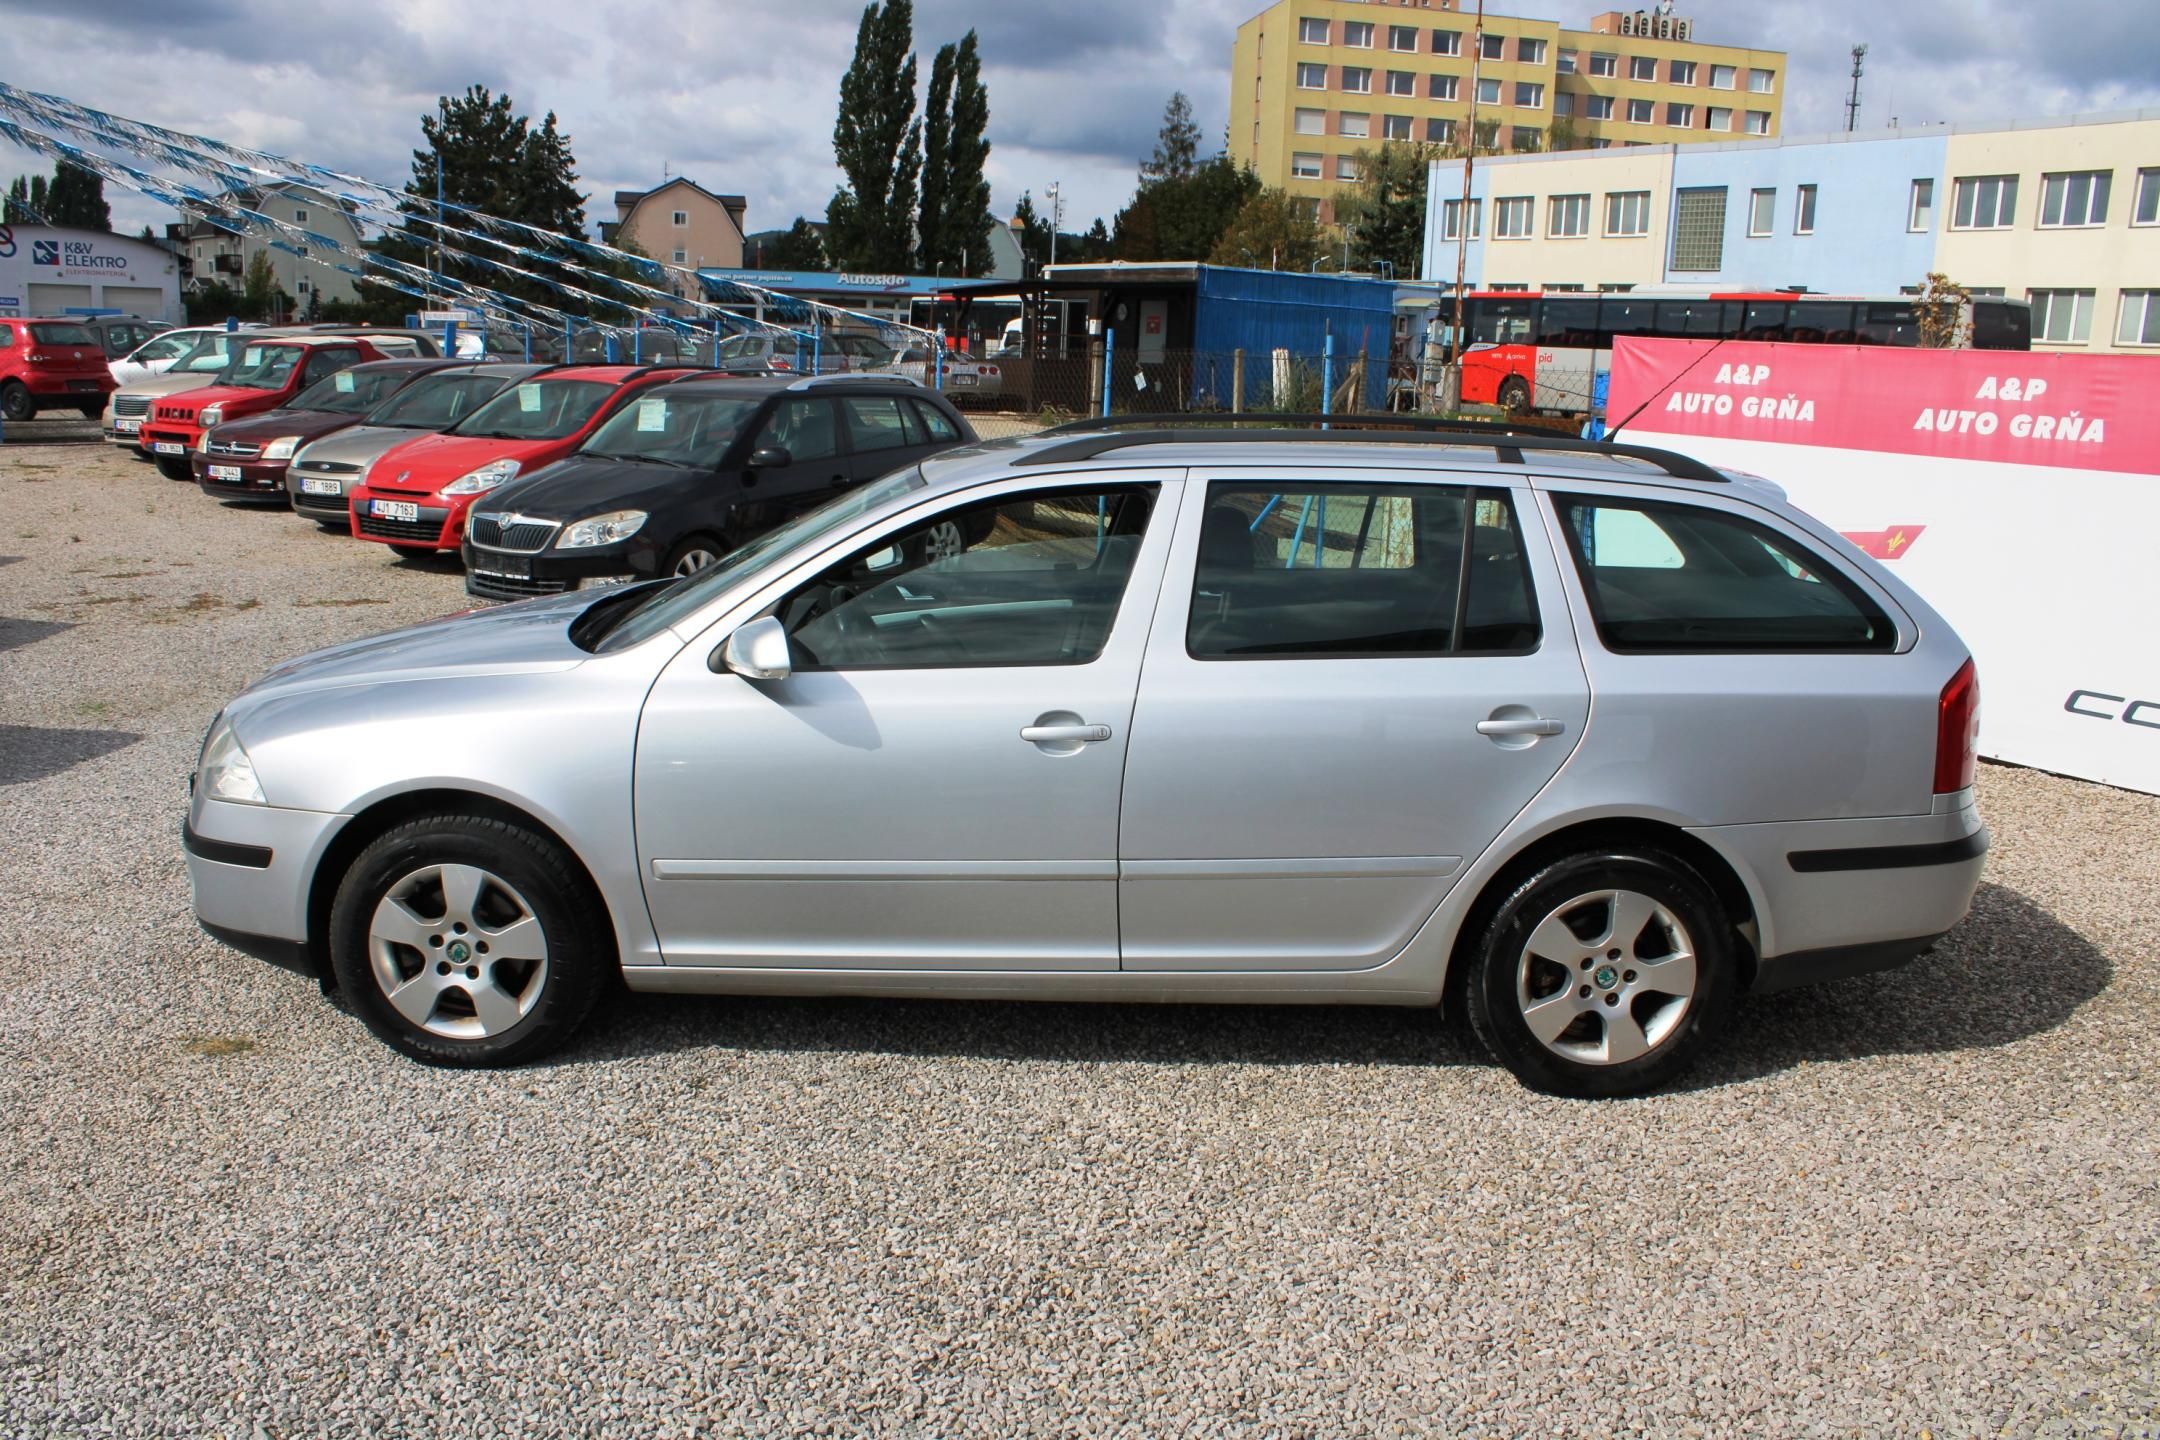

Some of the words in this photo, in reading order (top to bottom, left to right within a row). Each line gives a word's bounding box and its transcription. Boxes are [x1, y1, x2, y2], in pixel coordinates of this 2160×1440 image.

[64, 241, 94, 253] K&V
[65, 254, 127, 269] ELEKTRO
[837, 273, 905, 286] Autosklo
[1538, 353, 1553, 364] pid
[1713, 363, 1771, 386] A&P
[1975, 376, 2048, 402] A&P
[1665, 391, 1733, 416] AUTO
[1741, 393, 1815, 422] GRŇA
[1913, 408, 1999, 435] AUTO
[2009, 410, 2105, 443] GRŇA
[305, 480, 316, 491] 5ST
[321, 481, 338, 492] 1889
[376, 500, 389, 513] 4J1
[394, 503, 414, 516] 7163
